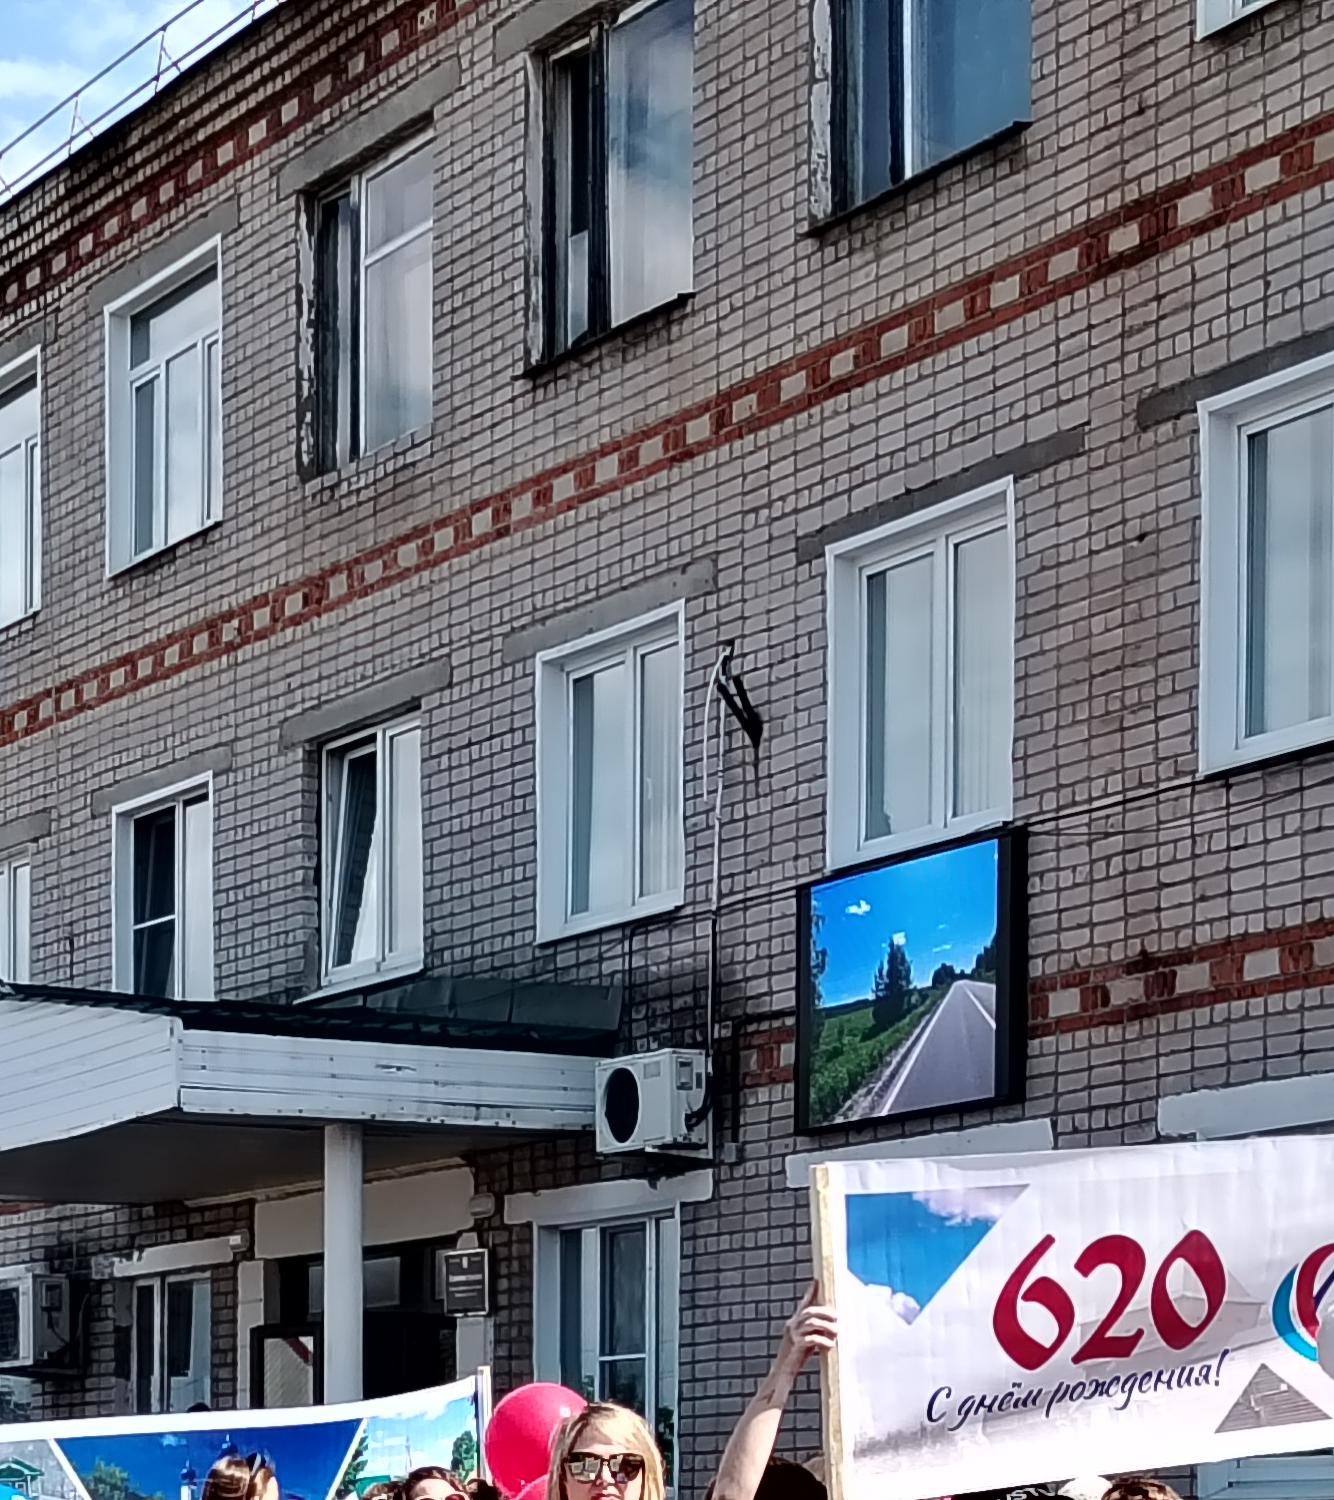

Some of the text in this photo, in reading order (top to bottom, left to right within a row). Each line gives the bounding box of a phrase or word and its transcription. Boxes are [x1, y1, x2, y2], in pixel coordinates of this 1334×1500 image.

[993, 1229, 1226, 1371] 620
[926, 1348, 1230, 1432] С днём рождения!
